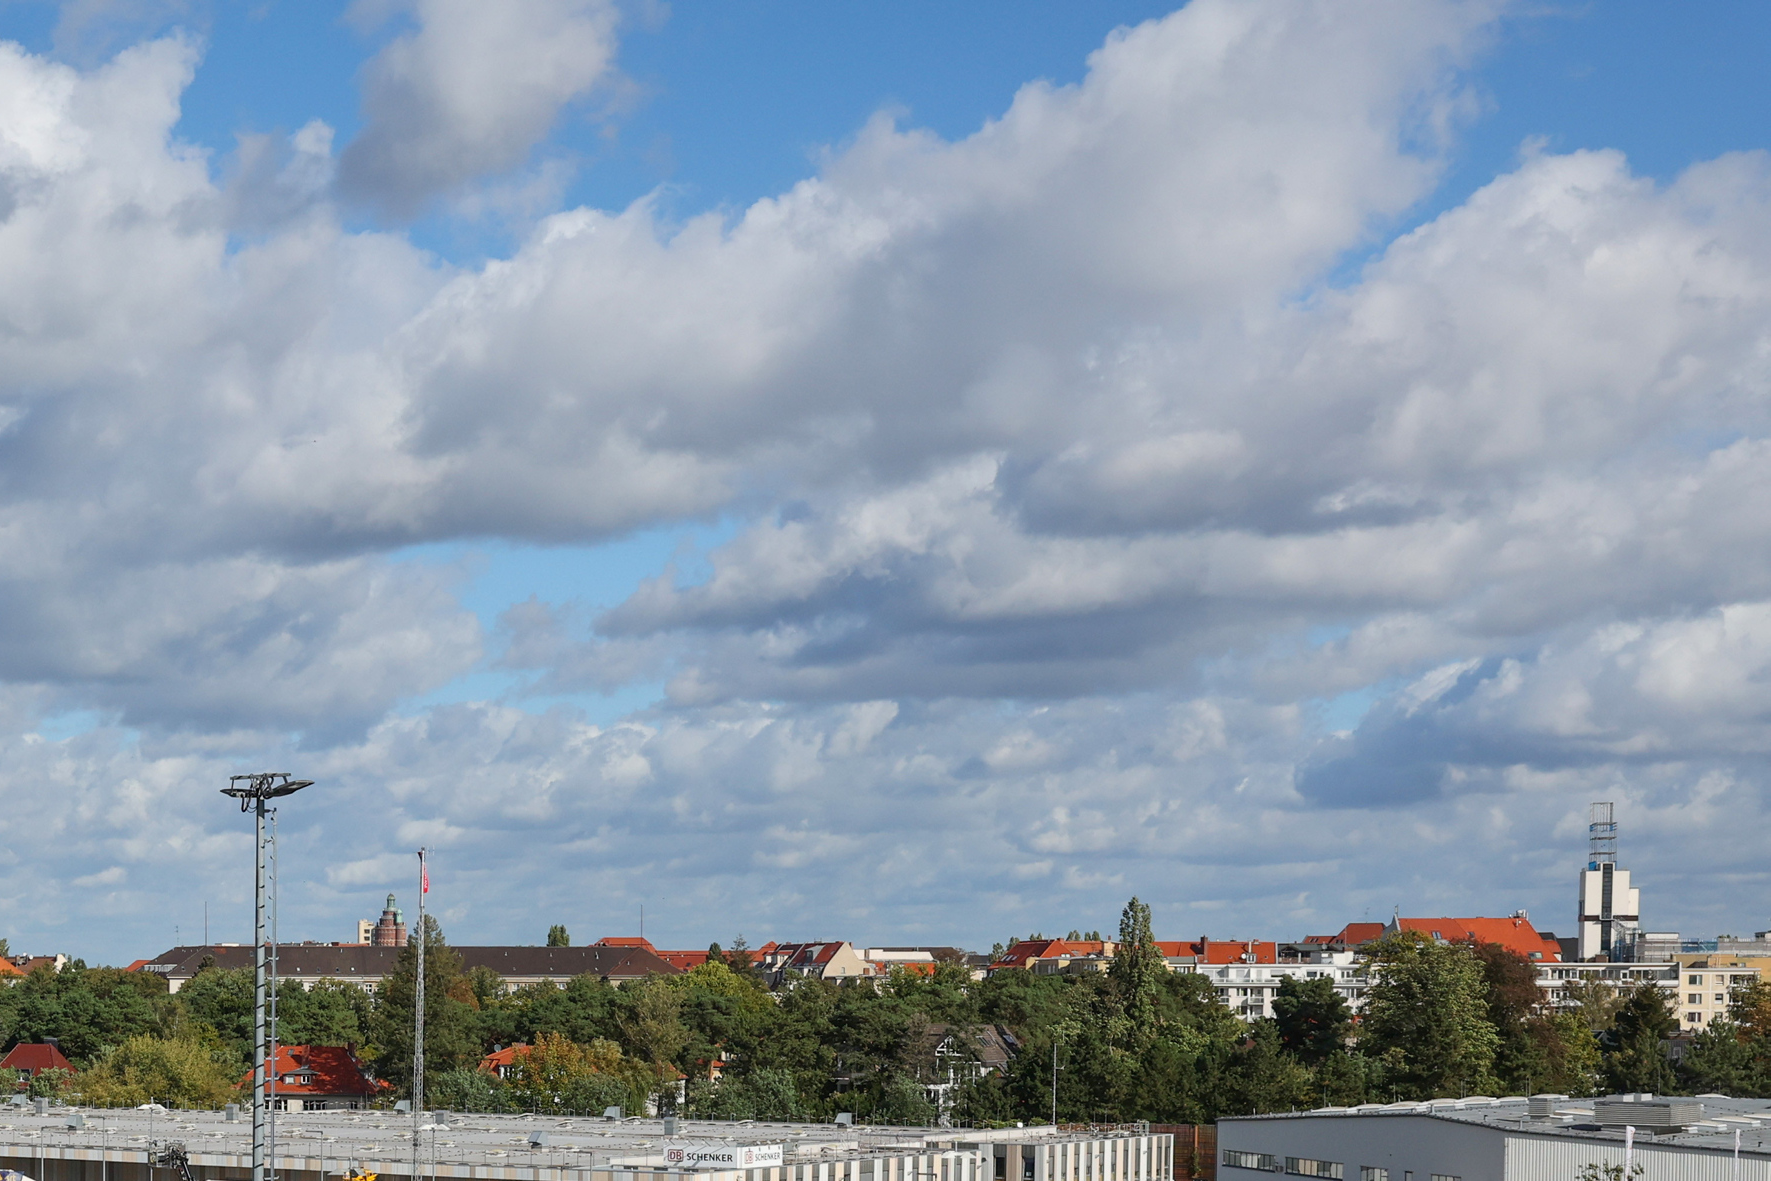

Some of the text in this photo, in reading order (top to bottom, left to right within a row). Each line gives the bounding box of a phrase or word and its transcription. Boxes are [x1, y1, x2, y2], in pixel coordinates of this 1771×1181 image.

[669, 1151, 733, 1163] DB SCHENKER
[746, 1151, 781, 1163] DB SCHENKER
